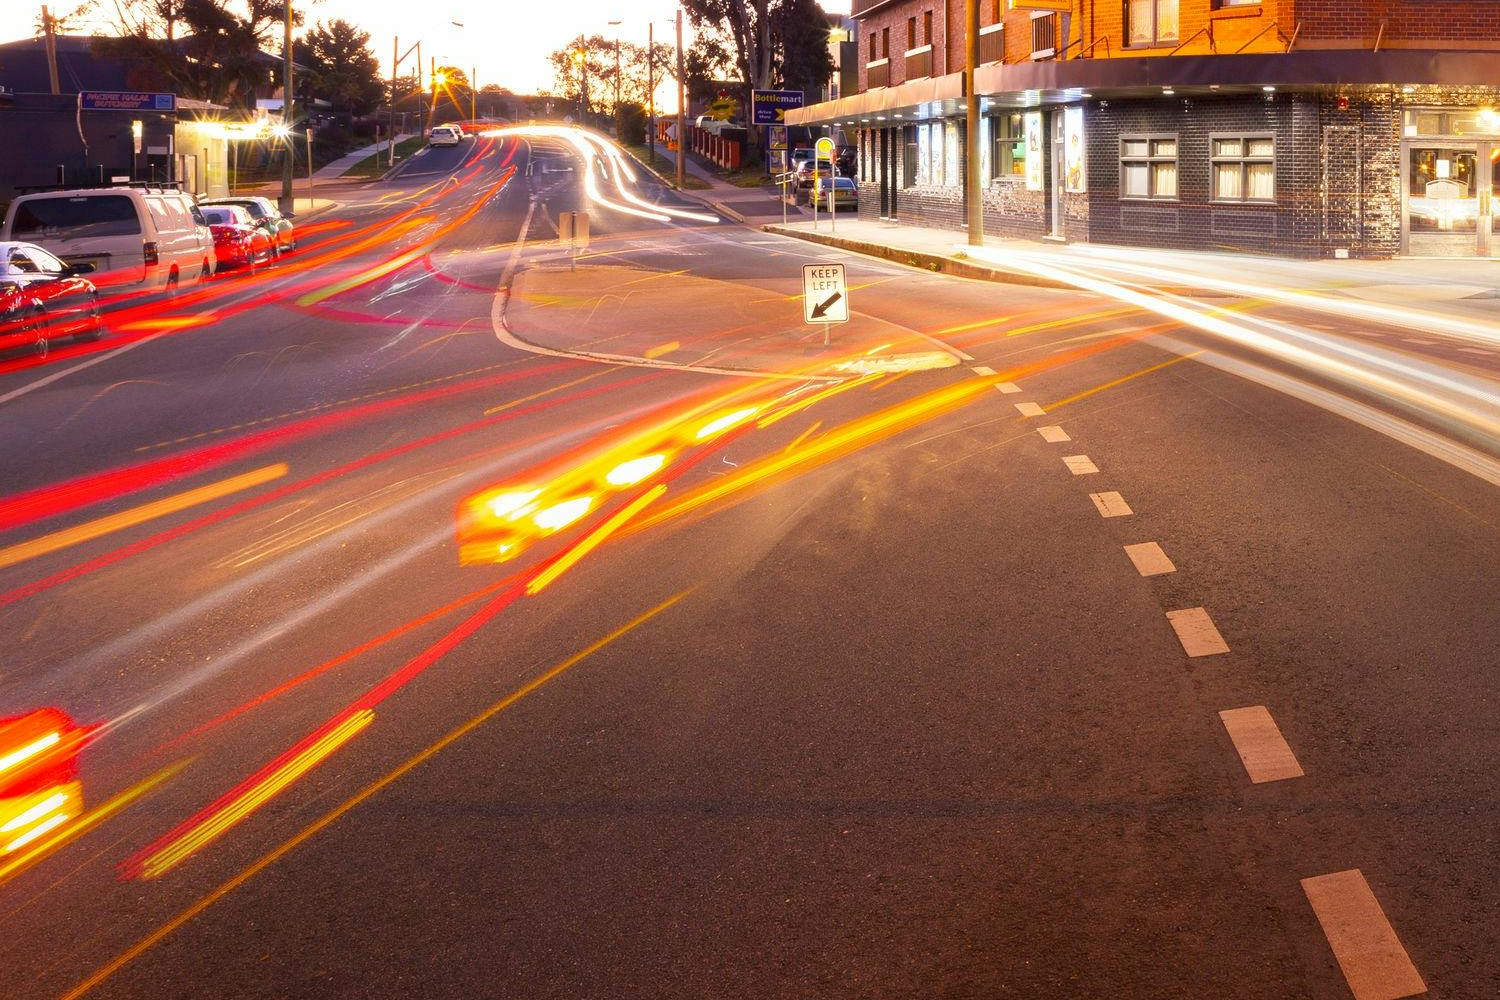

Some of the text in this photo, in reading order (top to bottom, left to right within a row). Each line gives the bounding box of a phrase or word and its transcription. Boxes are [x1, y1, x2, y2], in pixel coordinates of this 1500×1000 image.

[755, 94, 802, 103] Bottlemart
[811, 269, 839, 279] KEEP
[813, 281, 838, 291] LEFT
